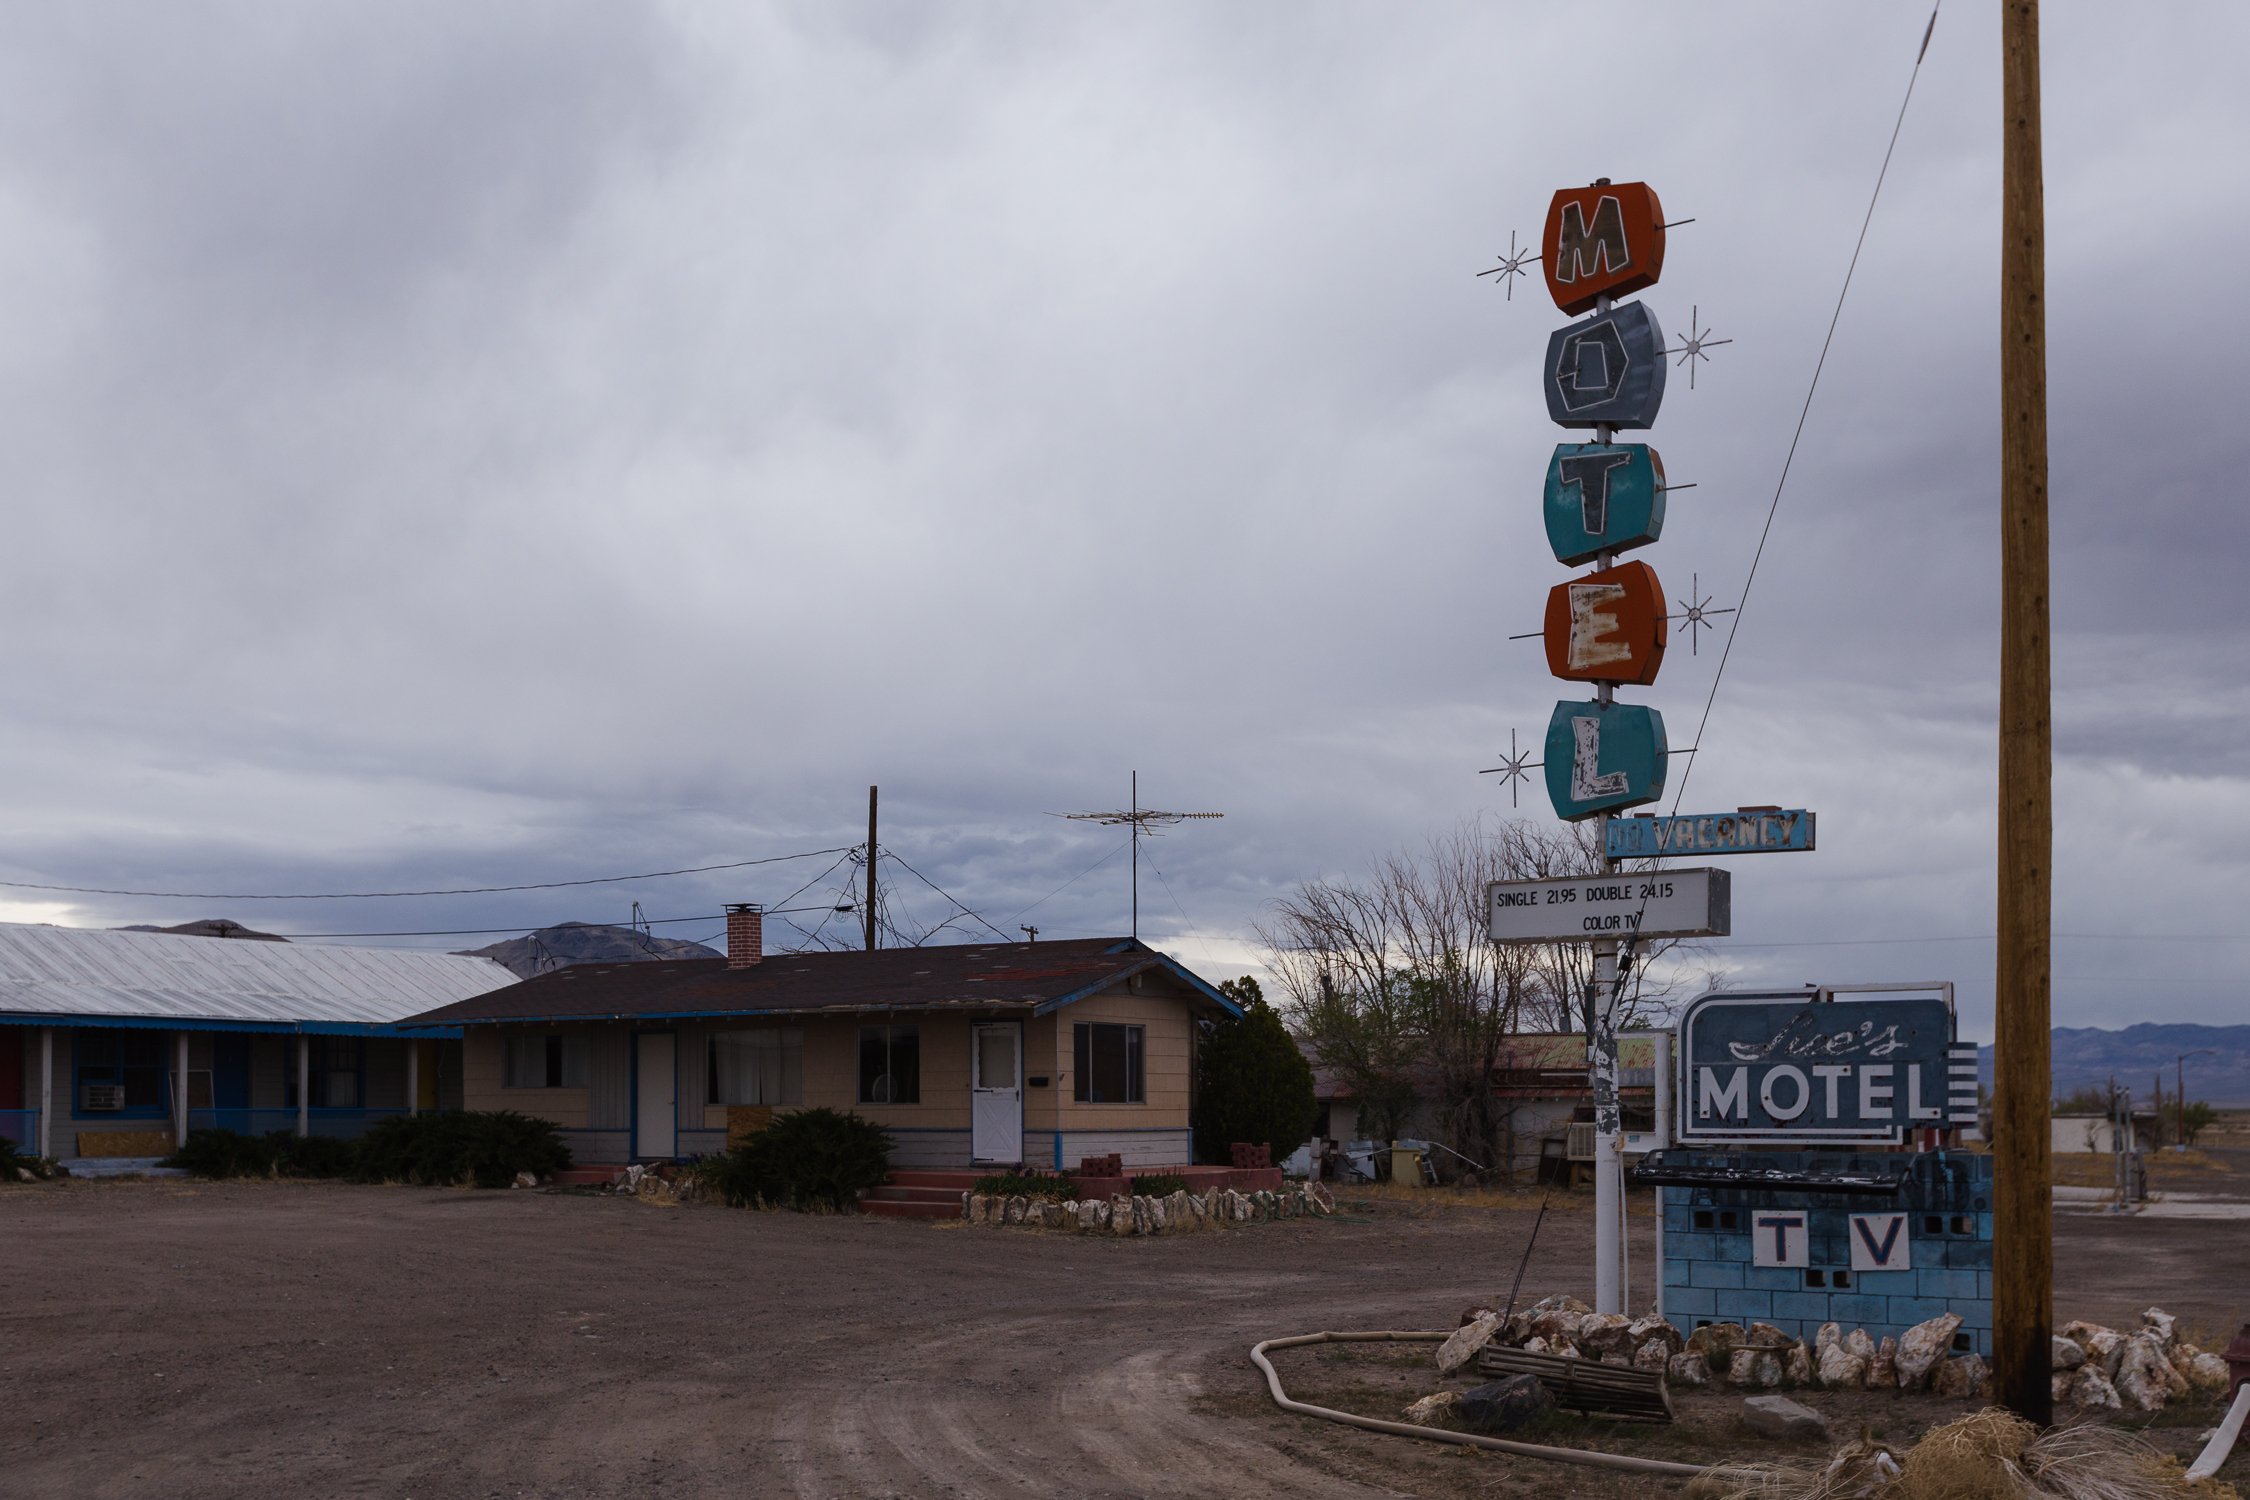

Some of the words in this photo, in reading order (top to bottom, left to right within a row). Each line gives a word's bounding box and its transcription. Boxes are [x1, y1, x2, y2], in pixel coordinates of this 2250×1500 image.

[1652, 813, 1800, 850] VACANCY
[1497, 890, 1538, 907] SINGLE
[1586, 885, 1632, 902] DOUBLE
[1583, 914, 1620, 931] COLOR
[1624, 914, 1640, 929] TV
[1700, 1064, 1941, 1120] MOTEL
